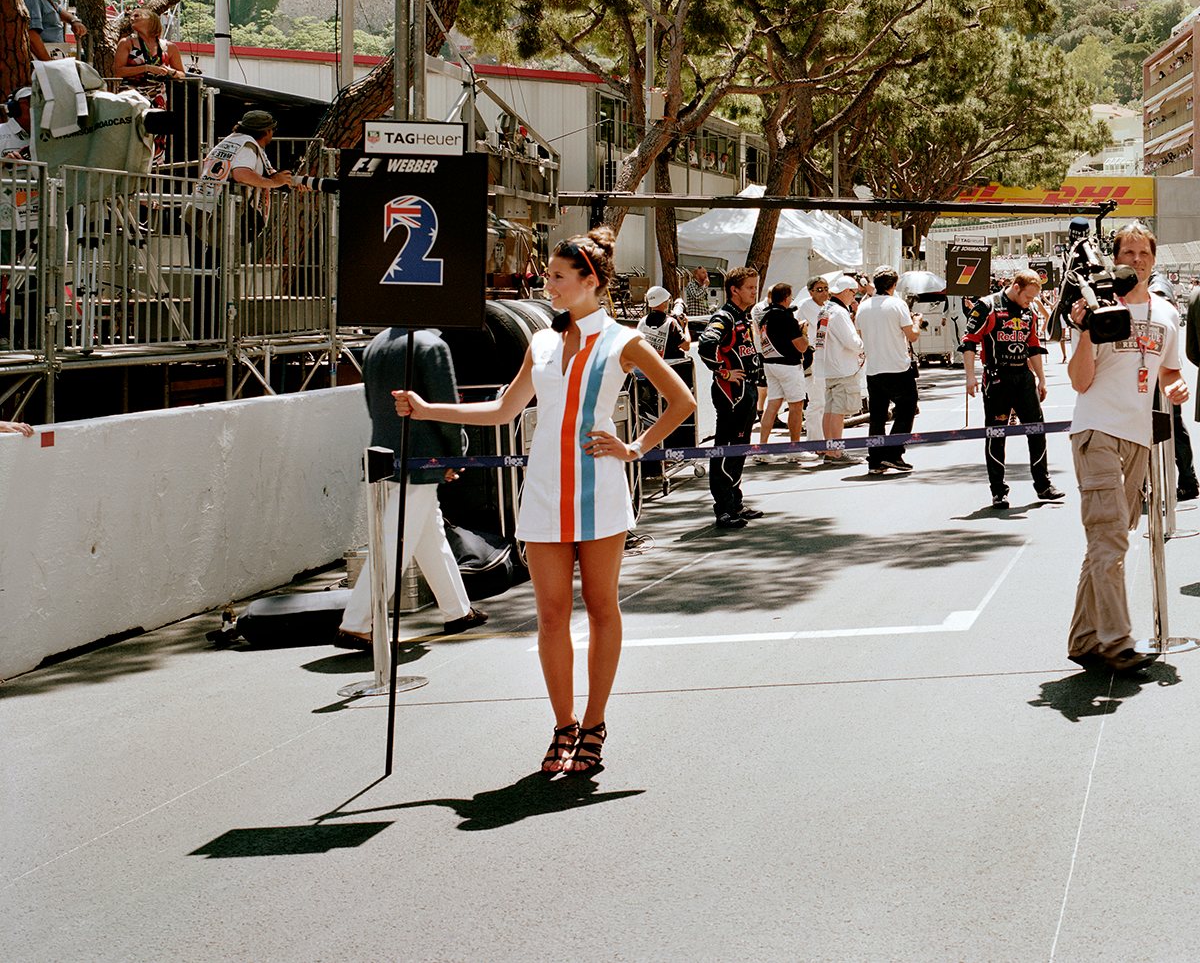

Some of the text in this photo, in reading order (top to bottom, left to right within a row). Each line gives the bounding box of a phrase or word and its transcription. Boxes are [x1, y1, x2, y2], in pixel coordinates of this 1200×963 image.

[386, 158, 439, 174] WEBBER
[1042, 185, 1135, 206] DHL
[379, 194, 444, 286] 2
[956, 257, 982, 285] 7
[997, 331, 1017, 342] Red
[986, 427, 1005, 437] flex
[826, 439, 846, 449] flex
[665, 448, 685, 459] flex
[504, 455, 524, 466] flex
